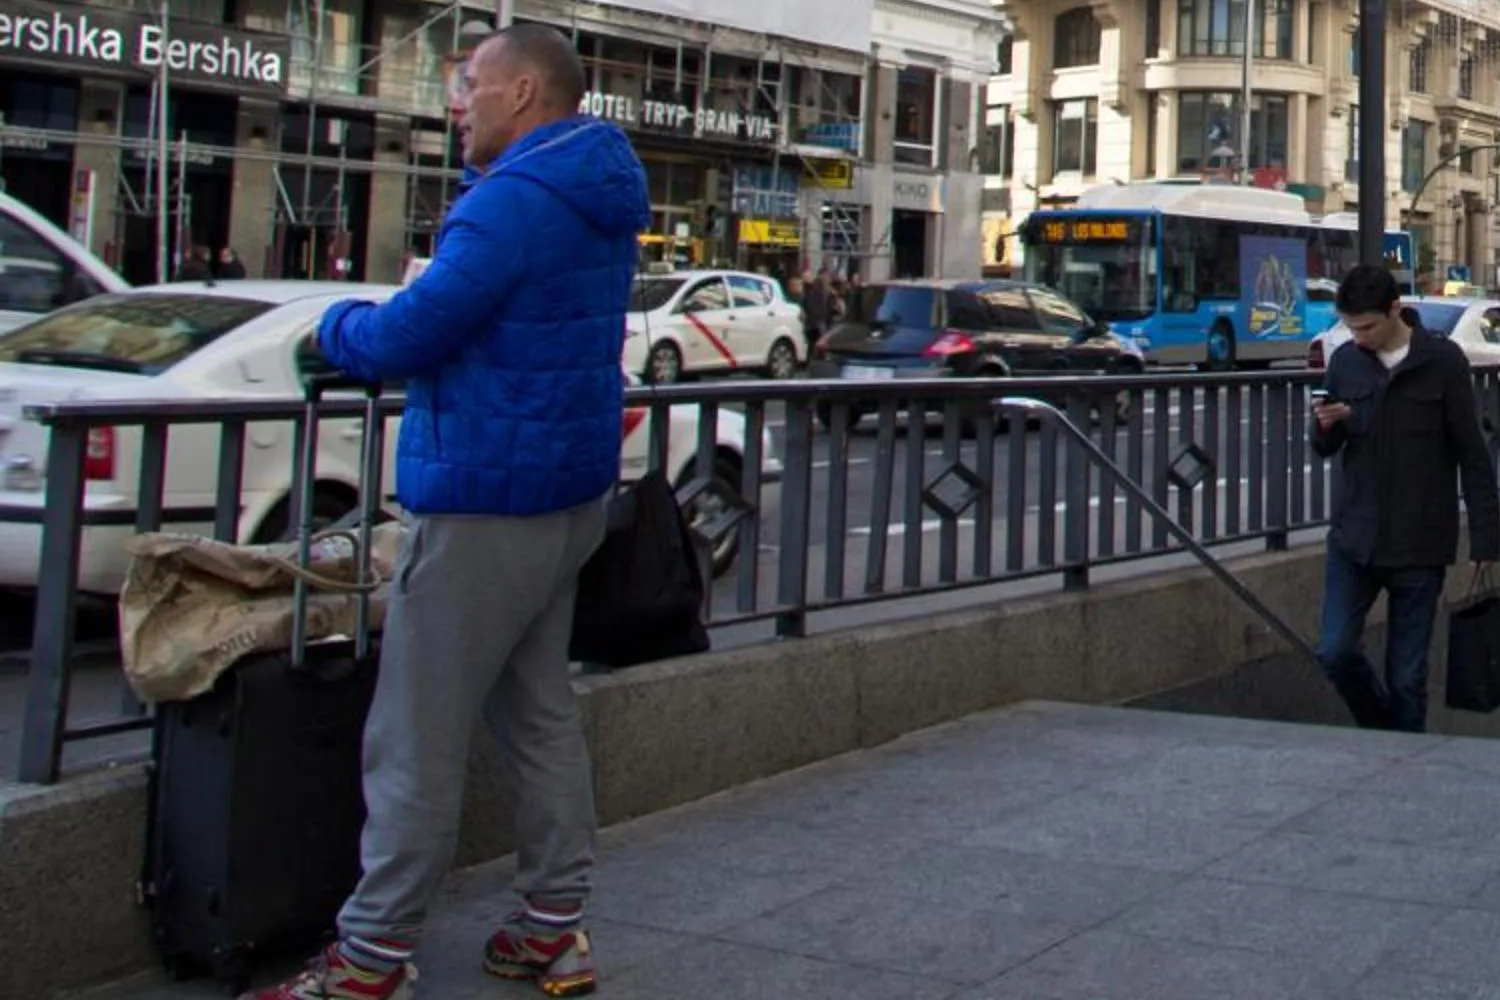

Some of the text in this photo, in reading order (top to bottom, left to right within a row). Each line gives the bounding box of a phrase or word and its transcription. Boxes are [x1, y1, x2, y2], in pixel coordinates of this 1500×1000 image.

[139, 24, 281, 82] Bershka
[578, 90, 773, 139] HOTEL TRYP GRAN VIA
